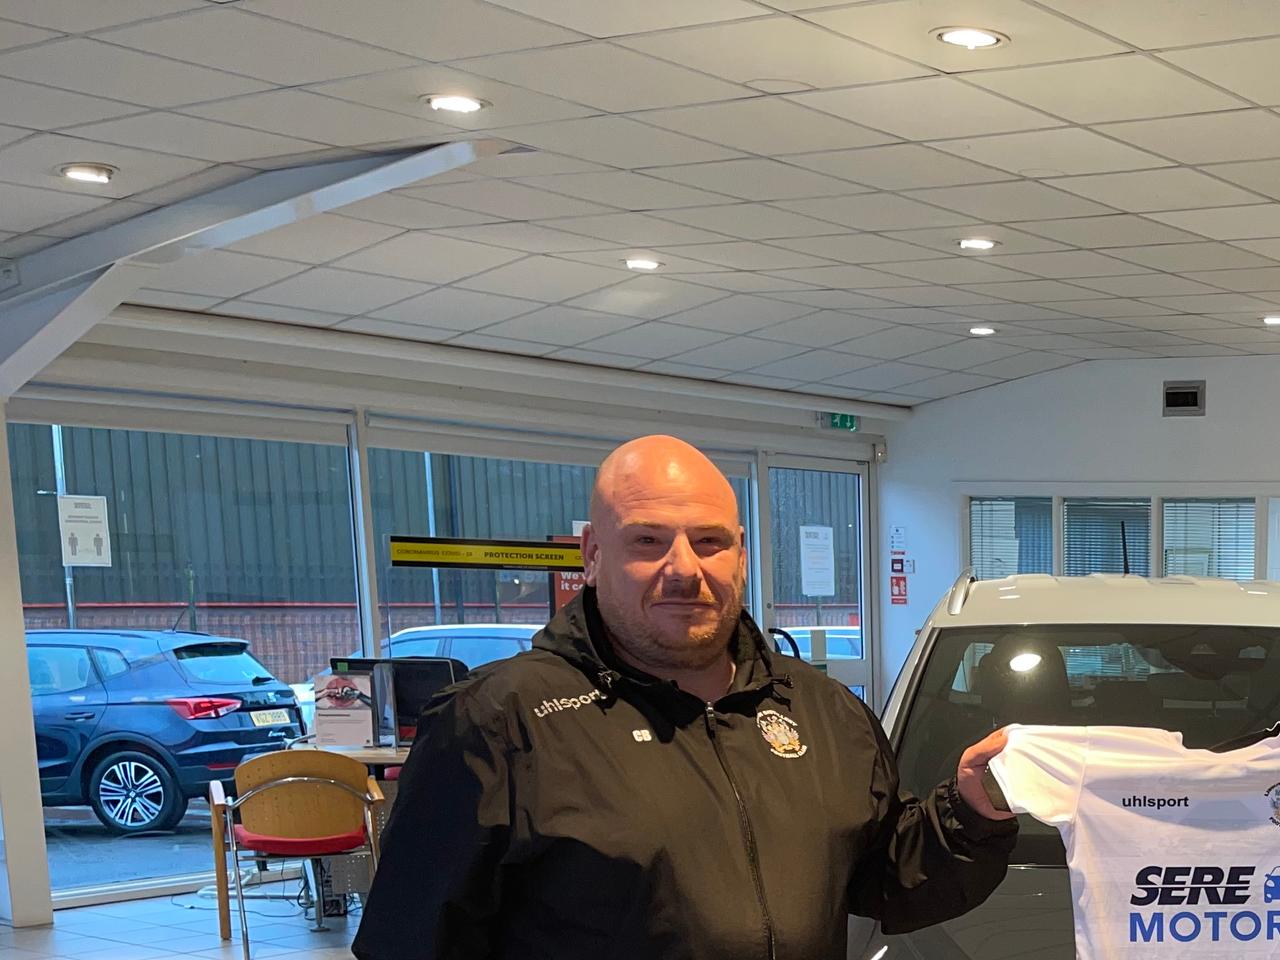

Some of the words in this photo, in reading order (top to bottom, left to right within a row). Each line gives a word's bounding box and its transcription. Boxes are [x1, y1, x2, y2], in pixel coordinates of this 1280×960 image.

[484, 551, 534, 560] PROTECTION
[535, 553, 564, 561] SCREEN
[561, 580, 570, 591] it
[1122, 795, 1190, 810] uhlsport
[1129, 865, 1257, 906] SERE
